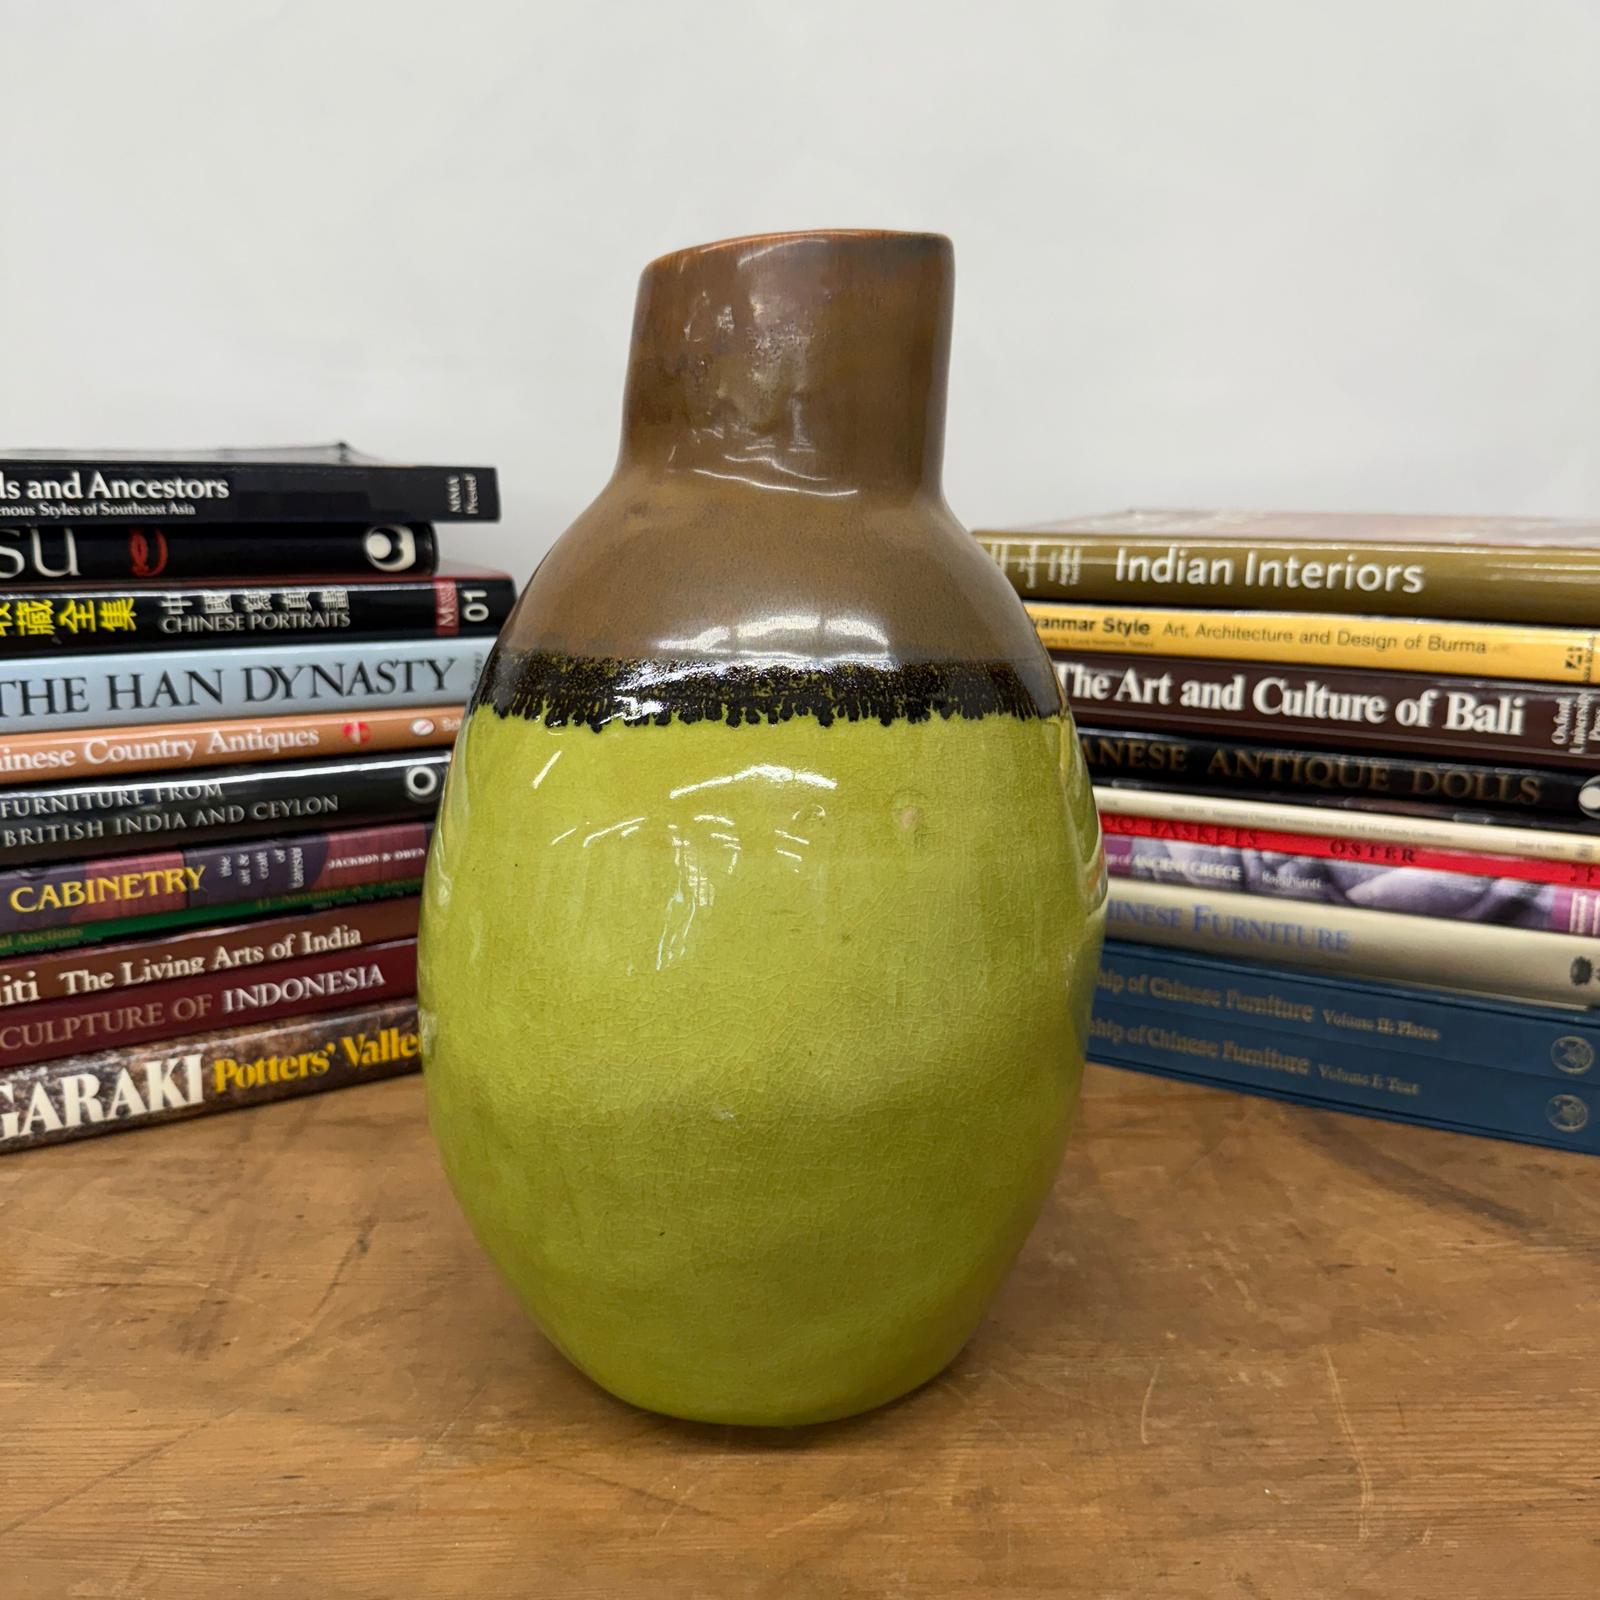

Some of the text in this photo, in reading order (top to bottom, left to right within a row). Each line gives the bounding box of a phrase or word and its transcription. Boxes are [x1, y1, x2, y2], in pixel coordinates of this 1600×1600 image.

[27, 471, 83, 499] and
[88, 471, 230, 499] Ancestors
[40, 502, 81, 519] Styles
[83, 503, 98, 516] of
[100, 502, 167, 516] Southeast
[169, 502, 196, 516] Asia
[1116, 544, 1235, 586] Indian
[1244, 550, 1425, 594] Interiors
[161, 610, 351, 634] CHINESE PORTRAITS
[462, 589, 489, 623] 01
[1103, 617, 1151, 637] Style
[1194, 622, 1294, 644] Architecture
[1299, 629, 1331, 645] and
[1336, 630, 1398, 652] Design
[1404, 633, 1424, 650] of
[1428, 636, 1487, 655] Burma
[0, 676, 90, 718] THE
[106, 669, 224, 711] HAN
[241, 658, 458, 702] DYNASTY
[1054, 661, 1527, 737] The Art and Culture of Bali
[84, 738, 198, 765] Country
[208, 726, 320, 755] Antiques
[1, 783, 223, 819] FURNITURE FROM
[1207, 747, 1392, 792] ANTIQUE
[1411, 766, 1543, 806] DOLLS
[3, 795, 339, 848] BRITISH INDIA AND CEYLON
[327, 854, 380, 870] JACKSON
[1329, 839, 1416, 862] OSTER
[10, 864, 206, 913] CABINETRY
[1192, 903, 1350, 951] FURNITURE
[59, 968, 115, 996] The
[121, 955, 206, 987] Living
[213, 945, 265, 971] Arts
[271, 933, 297, 960] of
[301, 925, 363, 952] India
[1, 963, 388, 1051] CULPTURE OF INDONESIA
[1127, 974, 1146, 994] of
[1149, 976, 1221, 1009] Chinese
[1226, 988, 1315, 1022] Furniture
[1322, 1008, 1374, 1031] Volume
[213, 1042, 336, 1095] Potters'
[343, 1027, 421, 1069] Valle
[1127, 1019, 1149, 1045] of
[1148, 1027, 1219, 1059] Chinese
[1222, 1039, 1312, 1076] Furniture
[1318, 1063, 1370, 1087] Volume
